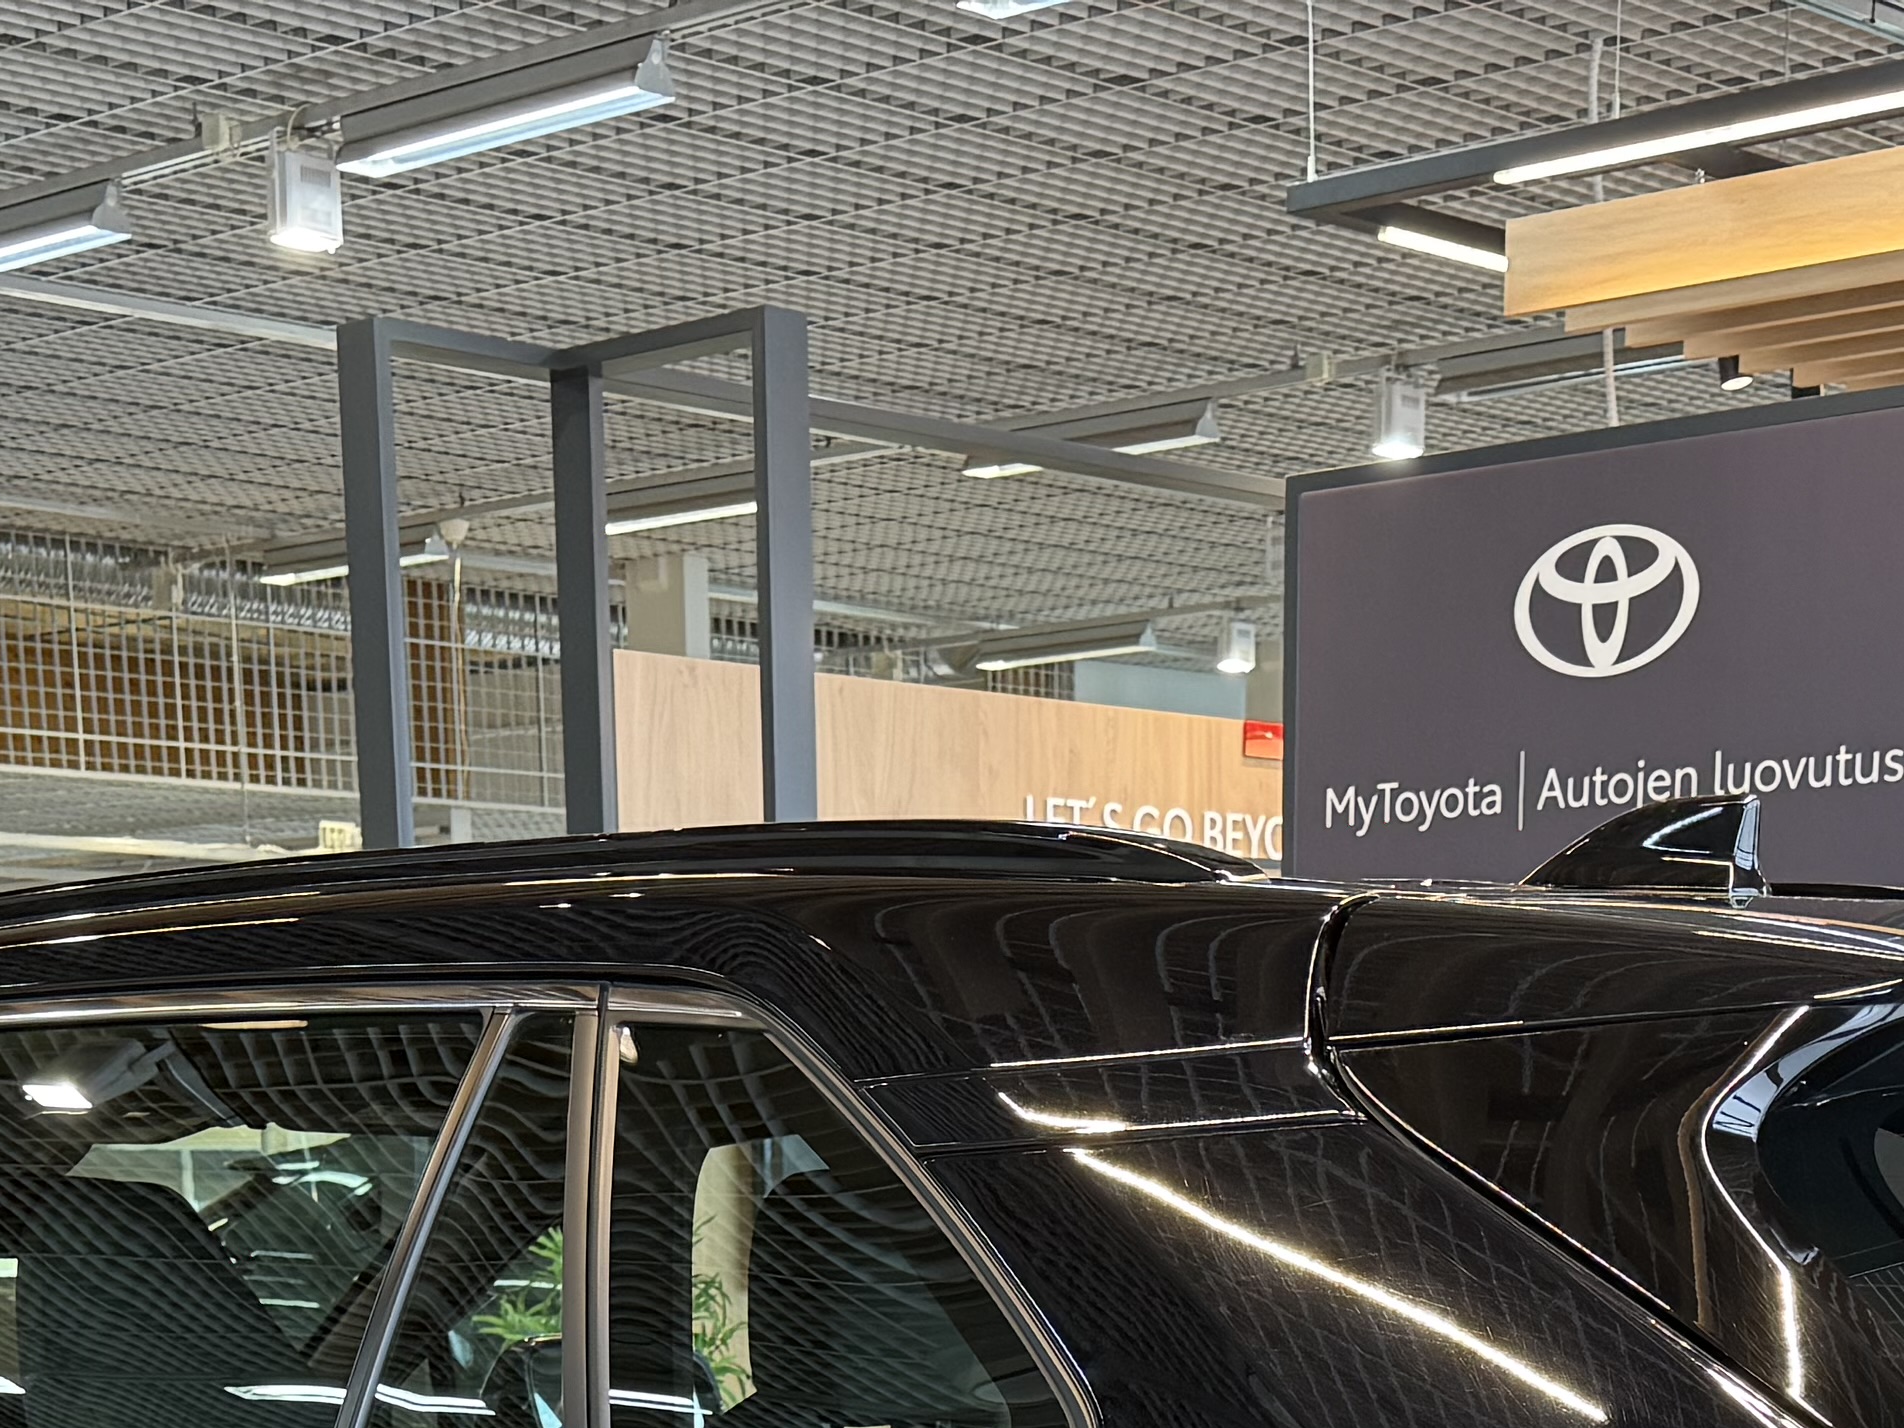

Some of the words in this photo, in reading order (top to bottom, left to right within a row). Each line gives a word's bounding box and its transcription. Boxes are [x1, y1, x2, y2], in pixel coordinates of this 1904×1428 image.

[1325, 780, 1502, 837] MyToyota
[1537, 760, 1698, 811] Autojen
[1713, 745, 1904, 797] luovutus
